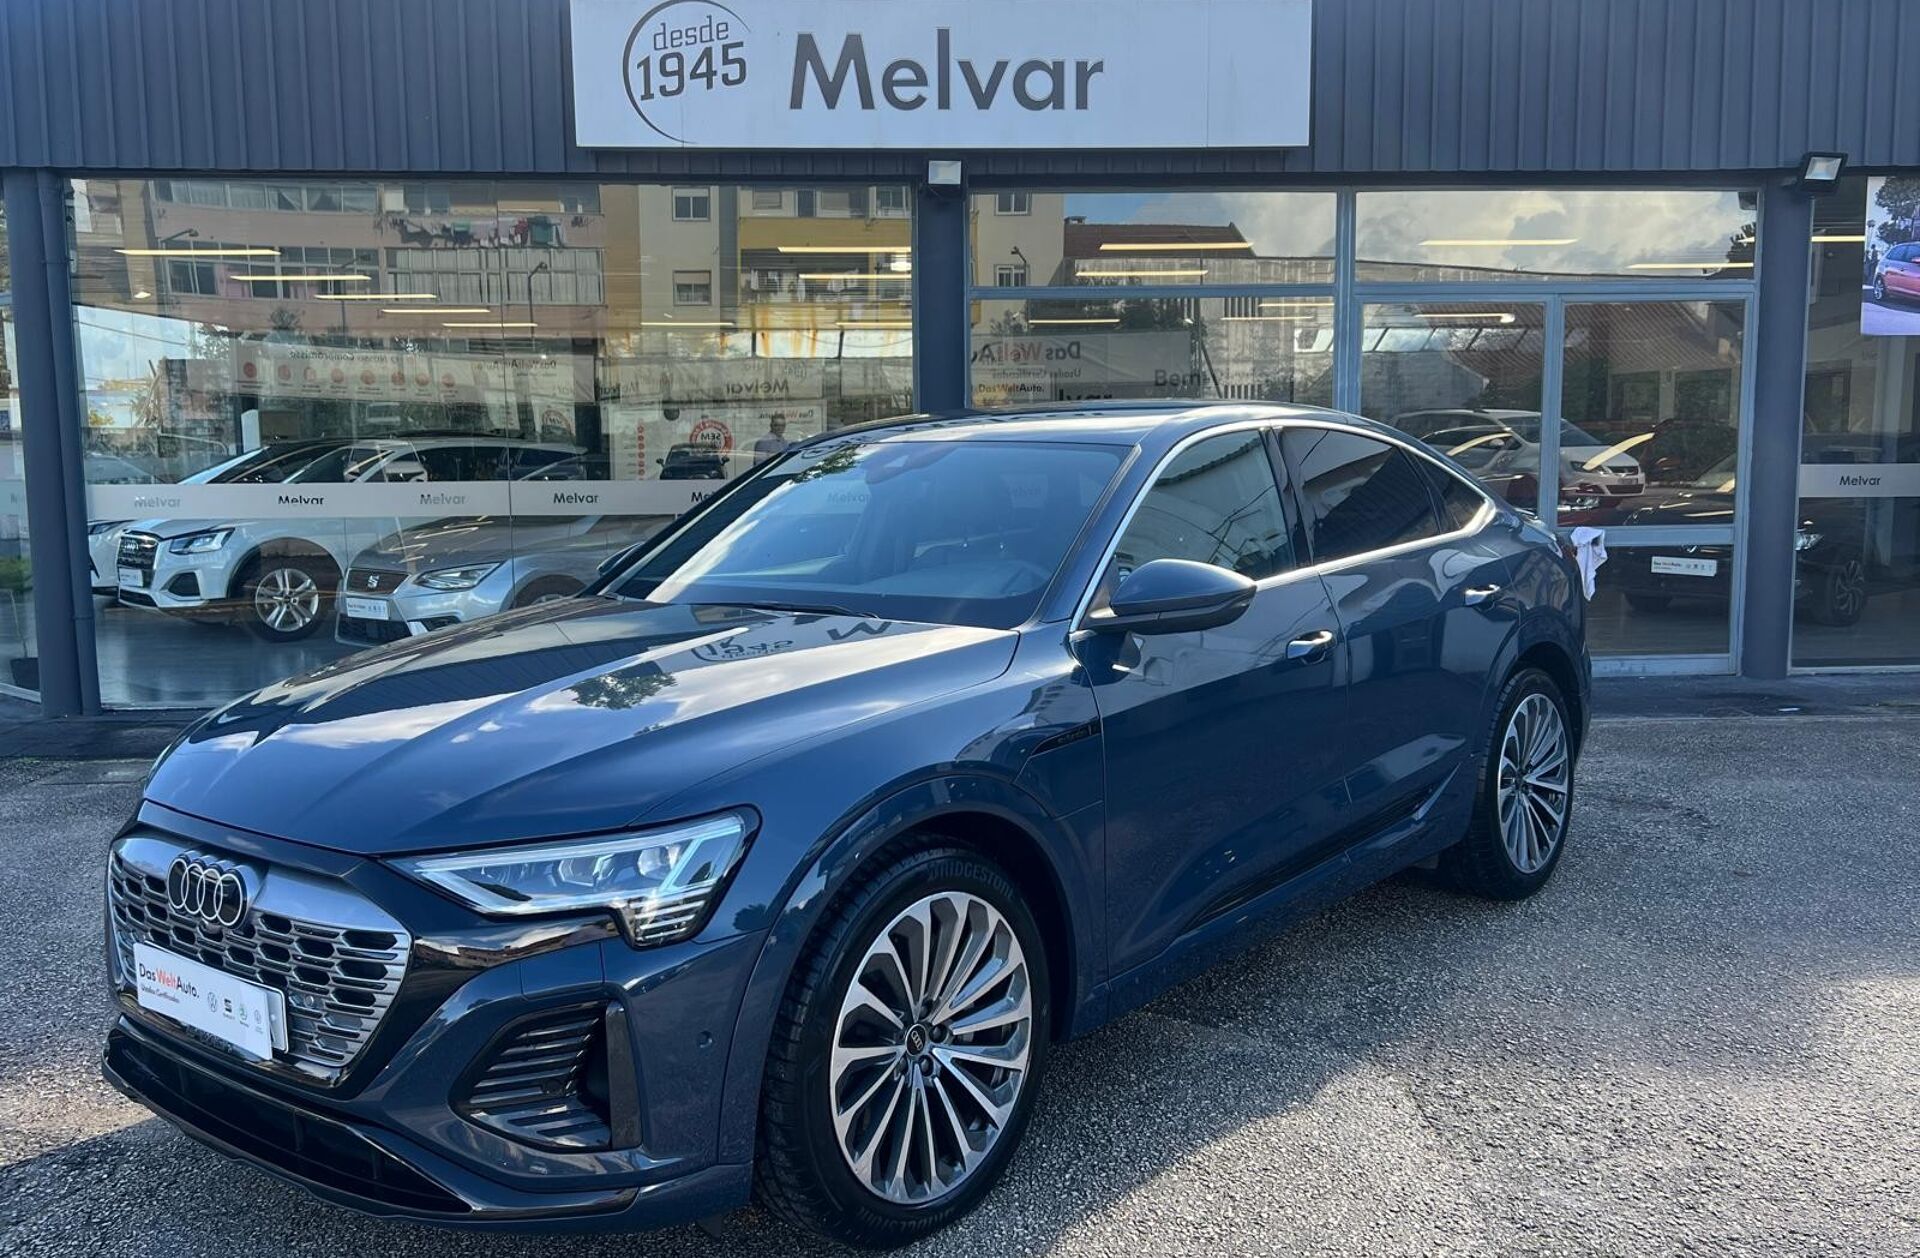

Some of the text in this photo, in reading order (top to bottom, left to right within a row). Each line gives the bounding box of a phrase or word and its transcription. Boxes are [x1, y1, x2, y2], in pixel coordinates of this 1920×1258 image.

[652, 15, 731, 51] desde
[637, 42, 747, 101] 1945
[789, 27, 1104, 111] Melvar
[1839, 474, 1881, 486] Melvar
[278, 494, 325, 506] Melvar
[420, 493, 466, 506] Melvar
[553, 492, 599, 505] Melvar
